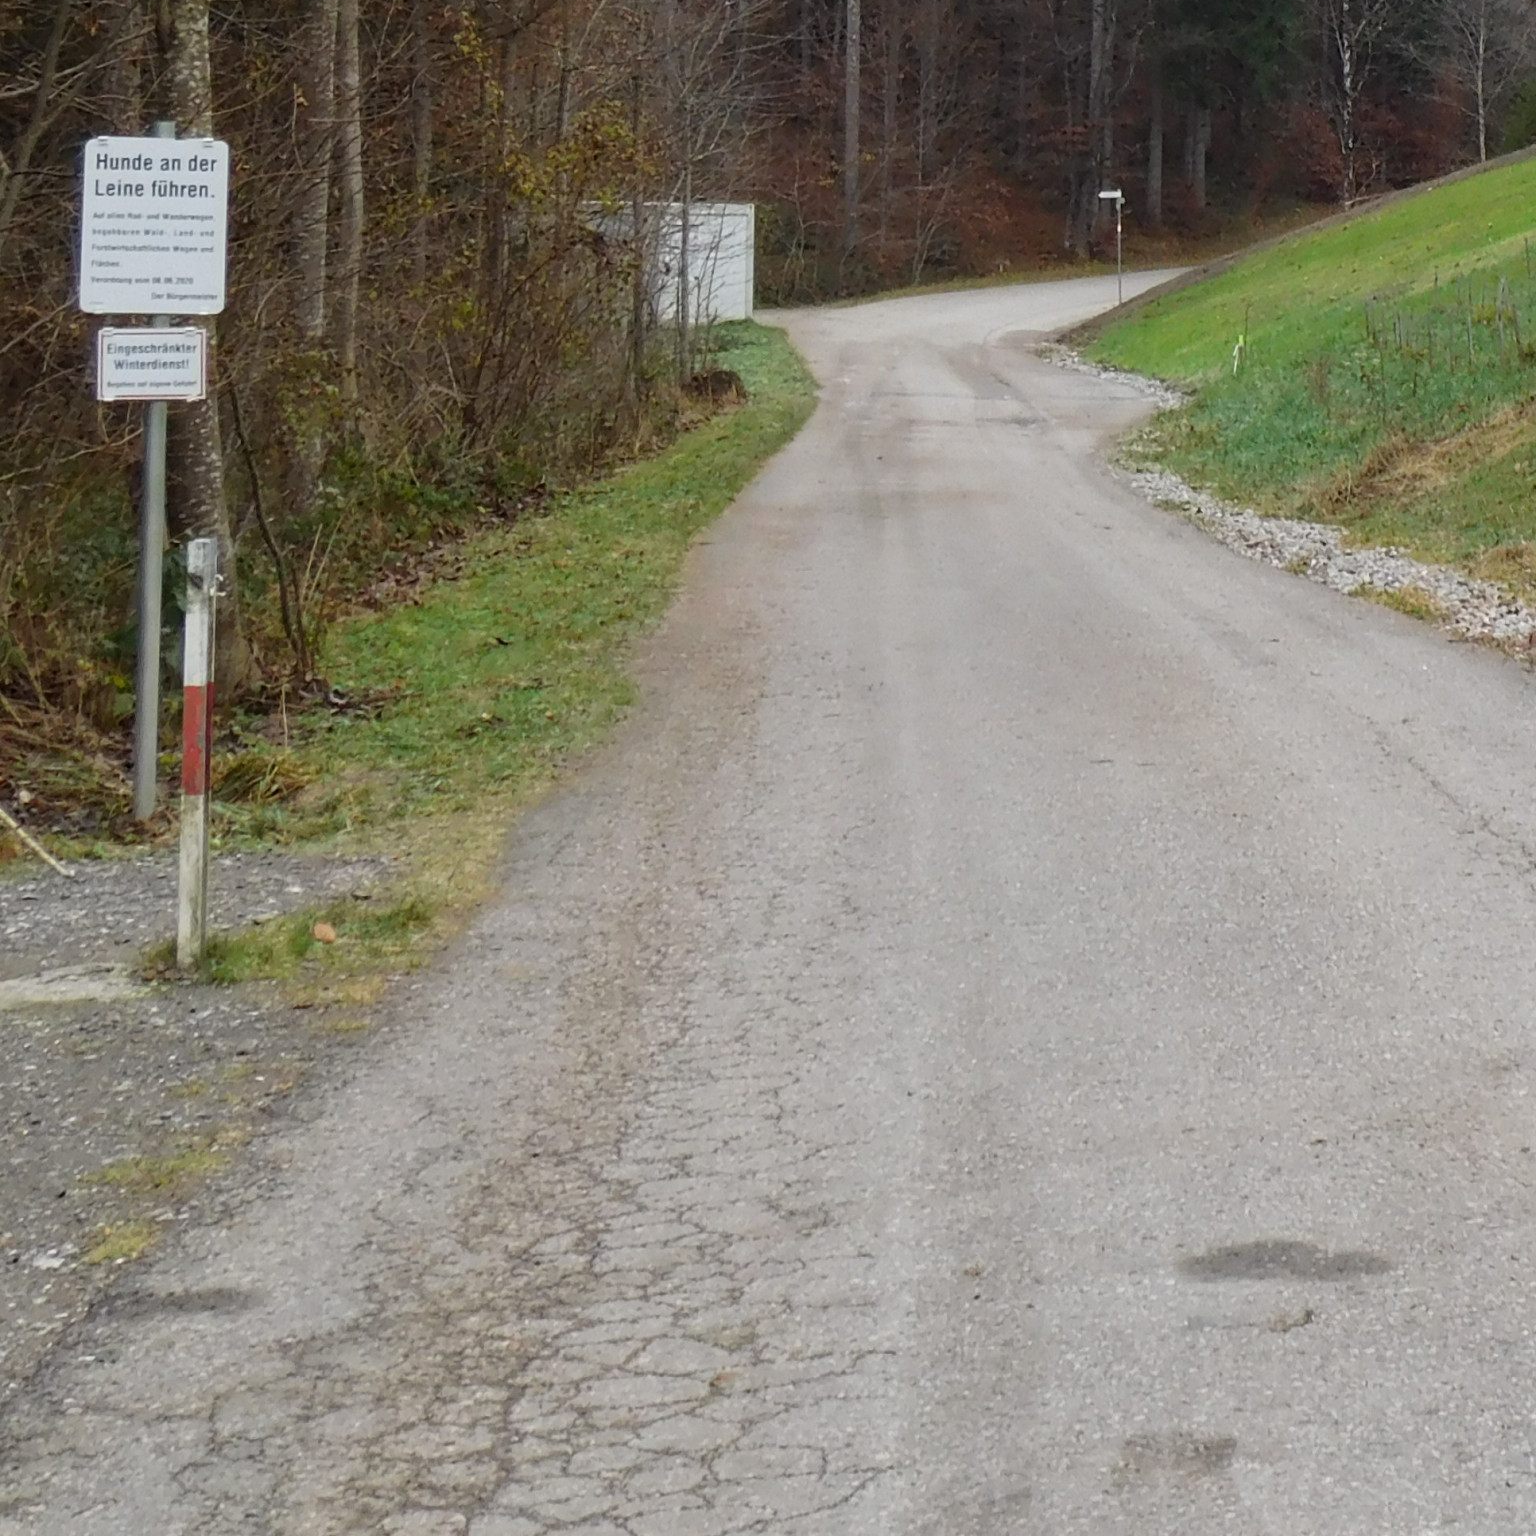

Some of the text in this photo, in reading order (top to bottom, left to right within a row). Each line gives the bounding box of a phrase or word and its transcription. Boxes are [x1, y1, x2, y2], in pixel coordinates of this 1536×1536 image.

[96, 153, 217, 172] Hunde an der
[95, 179, 215, 198] Leine führen.
[107, 343, 197, 355] Eingeschränkter
[113, 359, 190, 370] Winterdienst!
